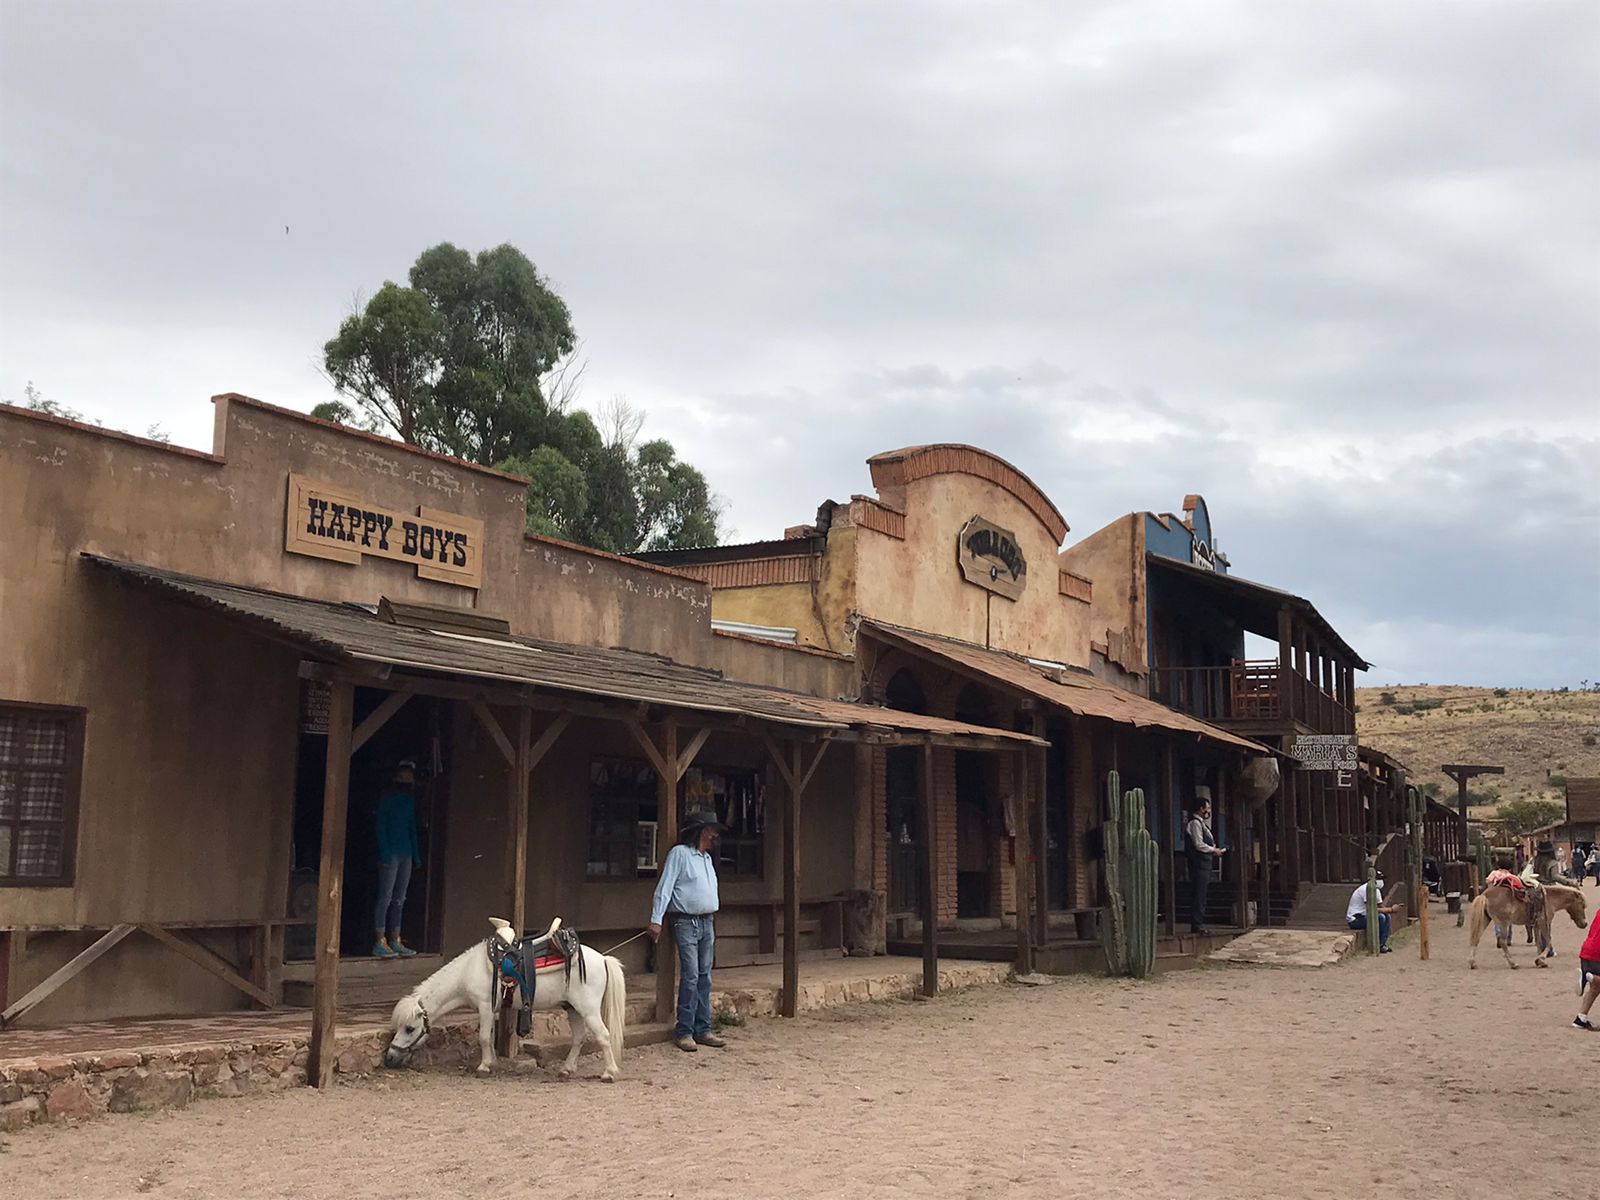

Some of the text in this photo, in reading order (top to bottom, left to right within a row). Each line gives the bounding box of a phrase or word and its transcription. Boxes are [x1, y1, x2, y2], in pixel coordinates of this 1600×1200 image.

[306, 497, 468, 567] HAPPY BOYS
[1333, 760, 1358, 770] FOOD
